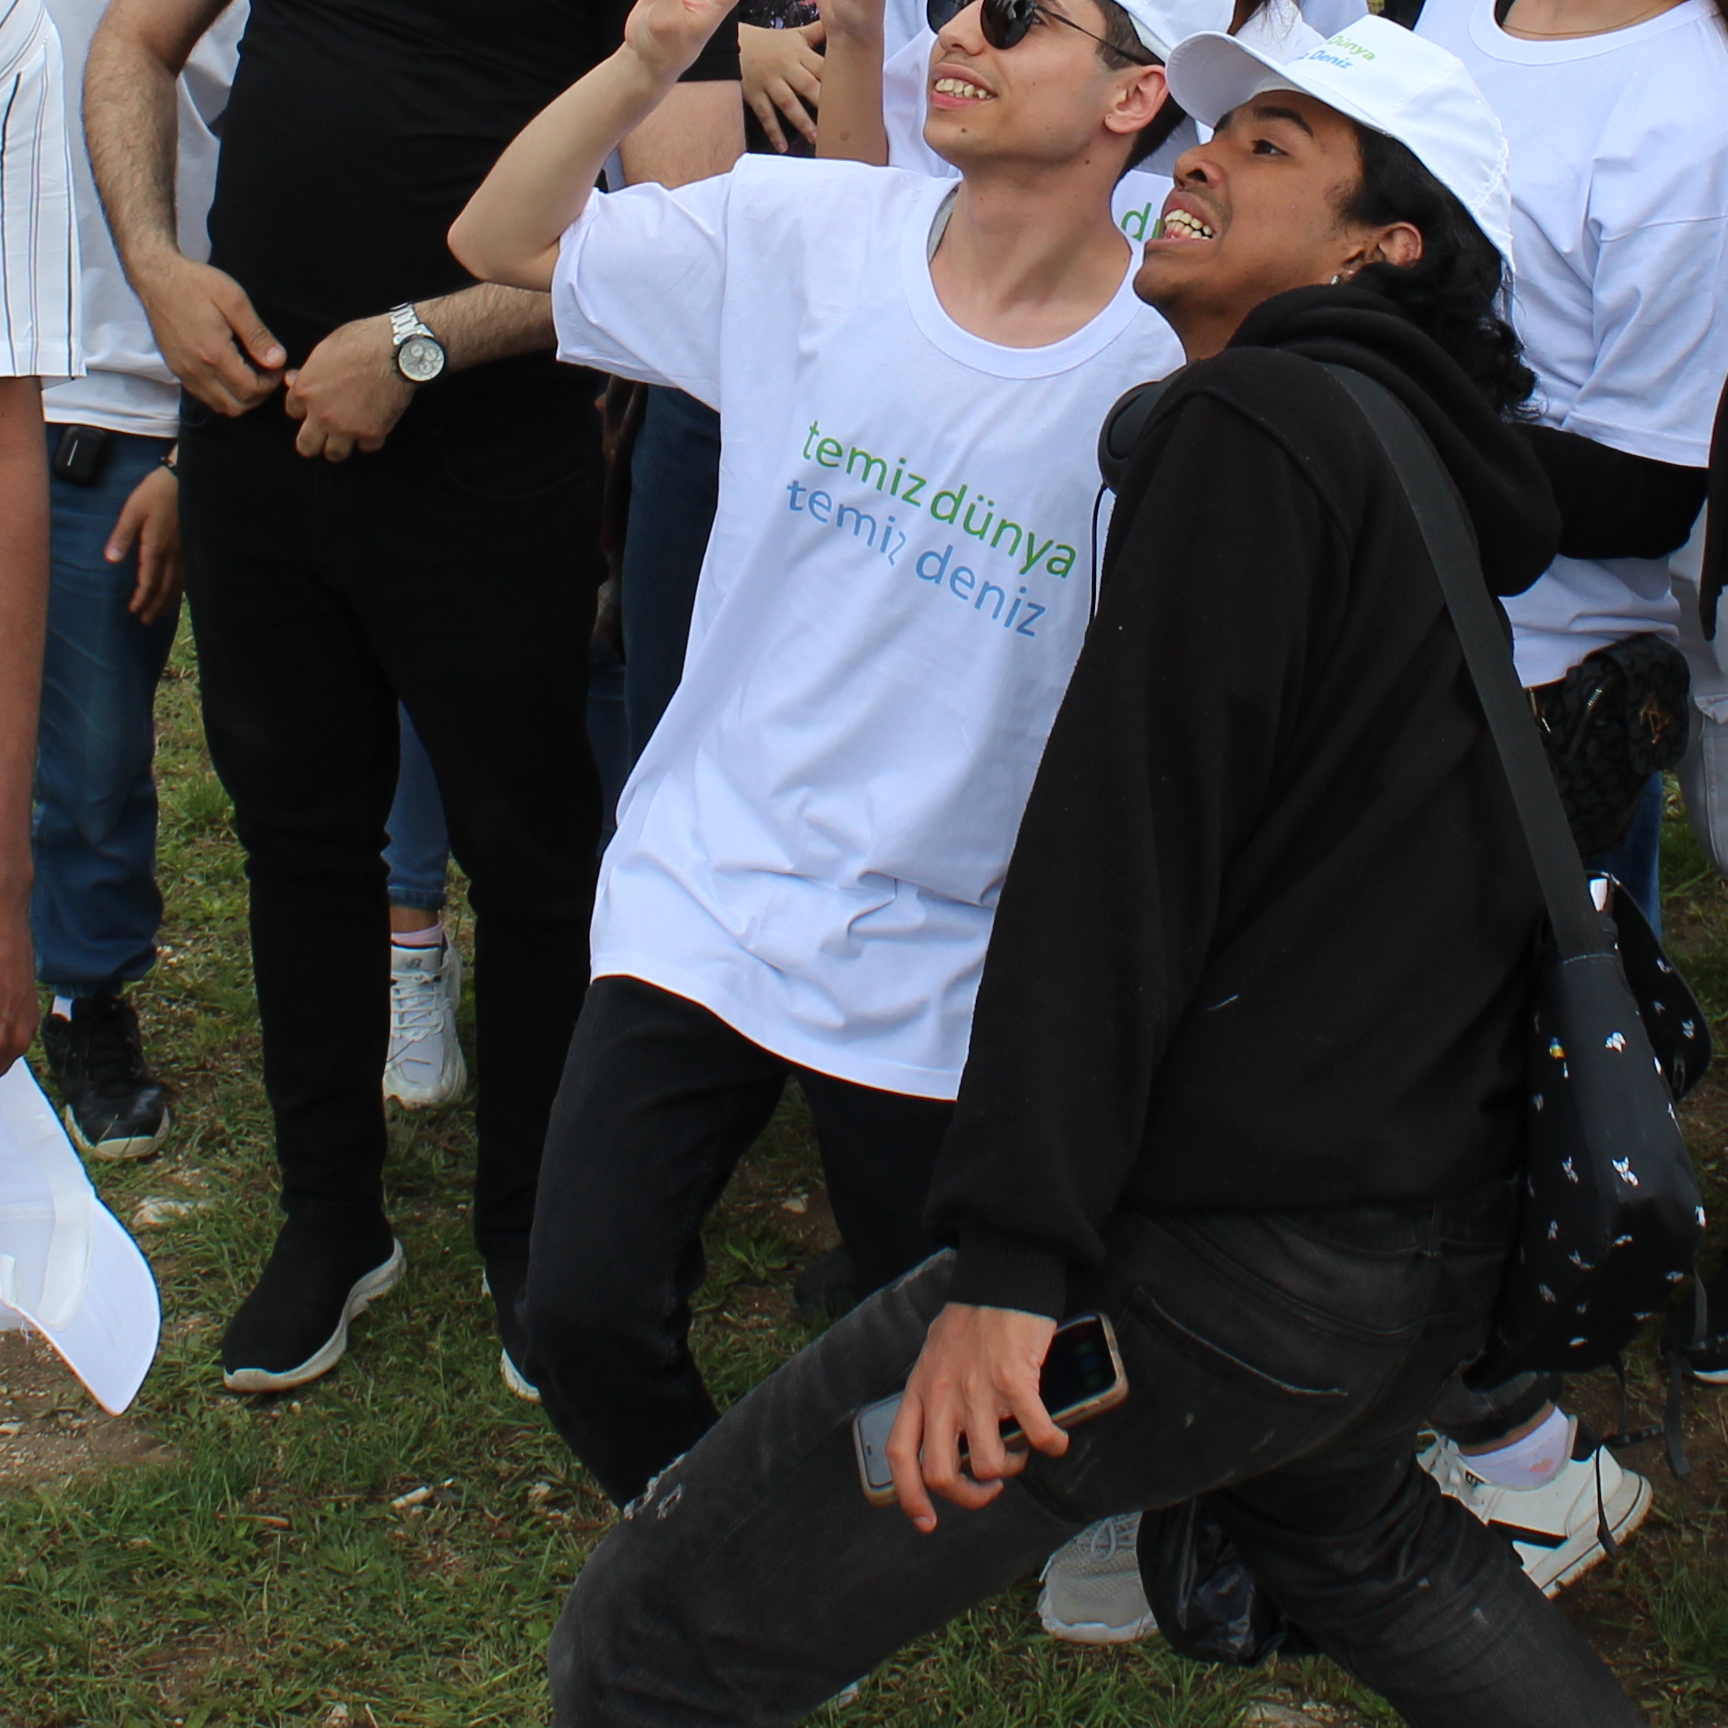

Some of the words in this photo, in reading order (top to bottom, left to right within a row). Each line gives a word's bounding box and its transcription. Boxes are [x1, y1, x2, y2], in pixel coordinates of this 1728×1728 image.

[1308, 49, 1354, 70] Deniz
[1326, 35, 1376, 61] Dünya
[802, 419, 927, 508] temiz
[929, 483, 1078, 579] dünya
[786, 479, 907, 567] temiz
[915, 544, 1047, 638] deniz
